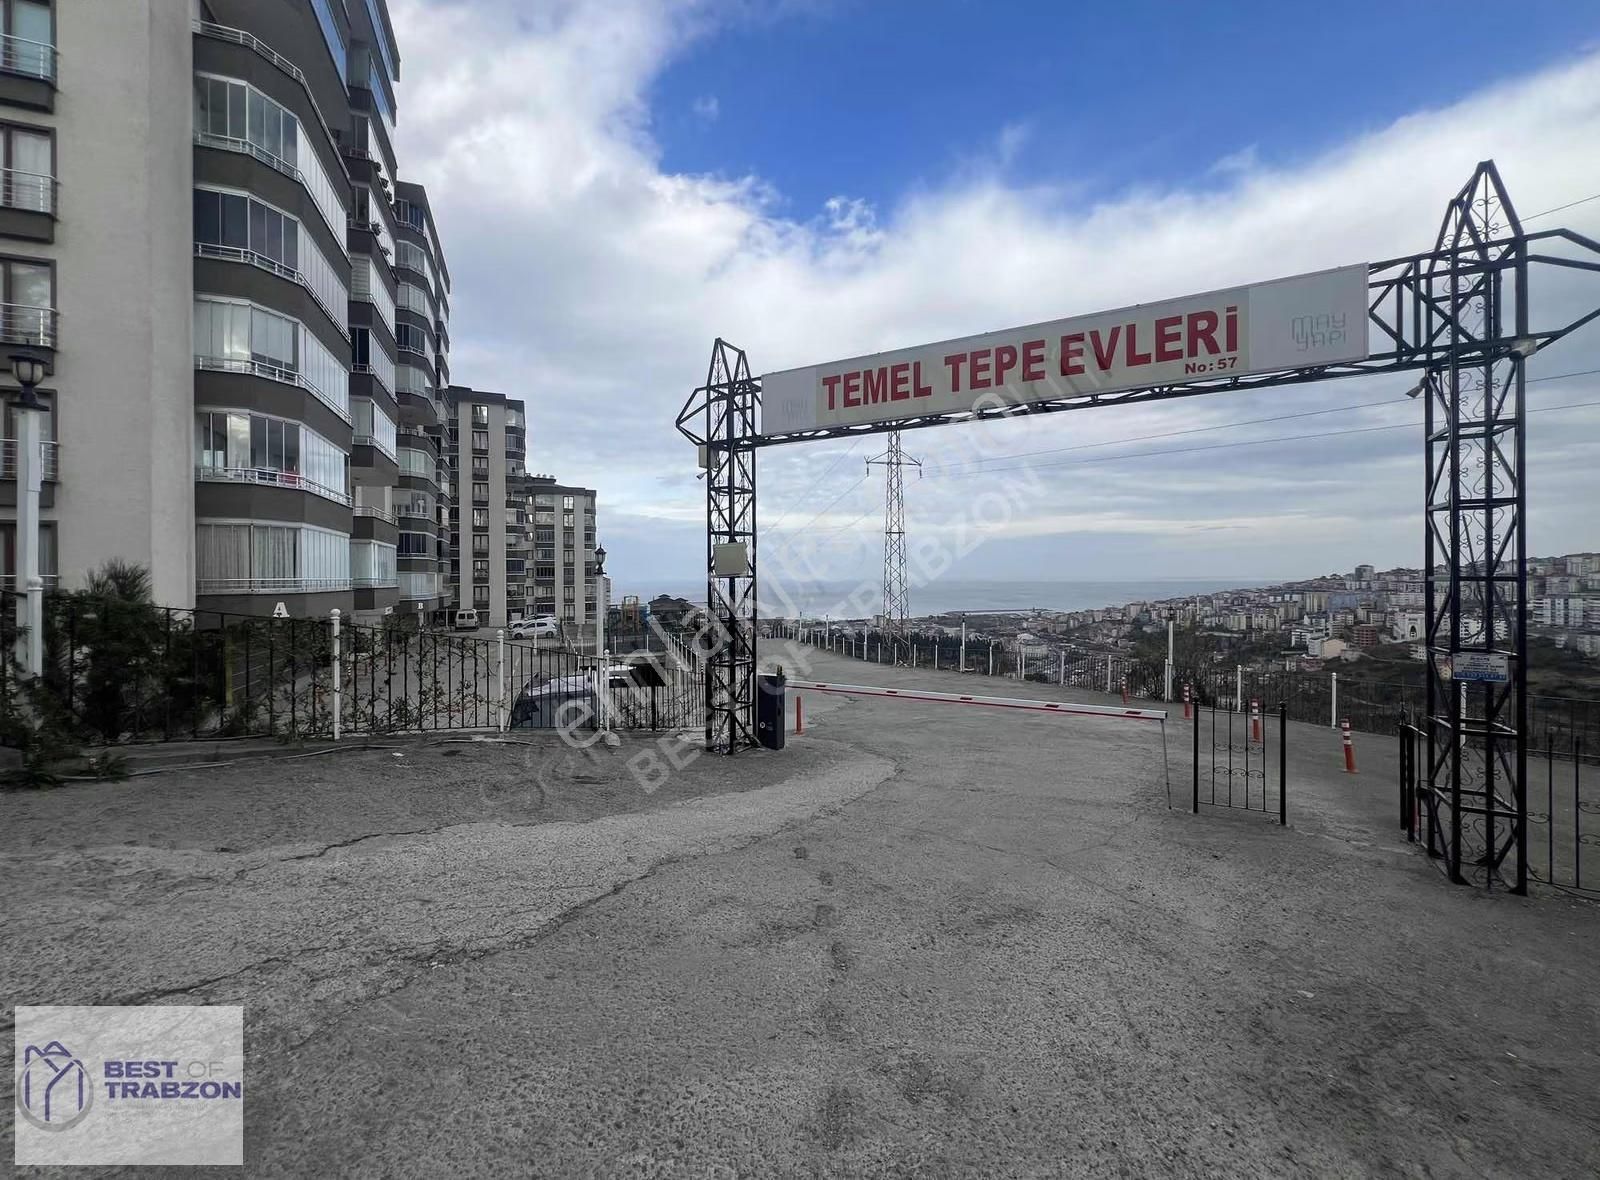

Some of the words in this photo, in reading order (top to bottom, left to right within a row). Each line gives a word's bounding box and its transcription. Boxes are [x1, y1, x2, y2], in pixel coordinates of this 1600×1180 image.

[822, 360, 933, 411] TEMEL
[944, 339, 1046, 392] TEPE
[273, 602, 290, 618] A
